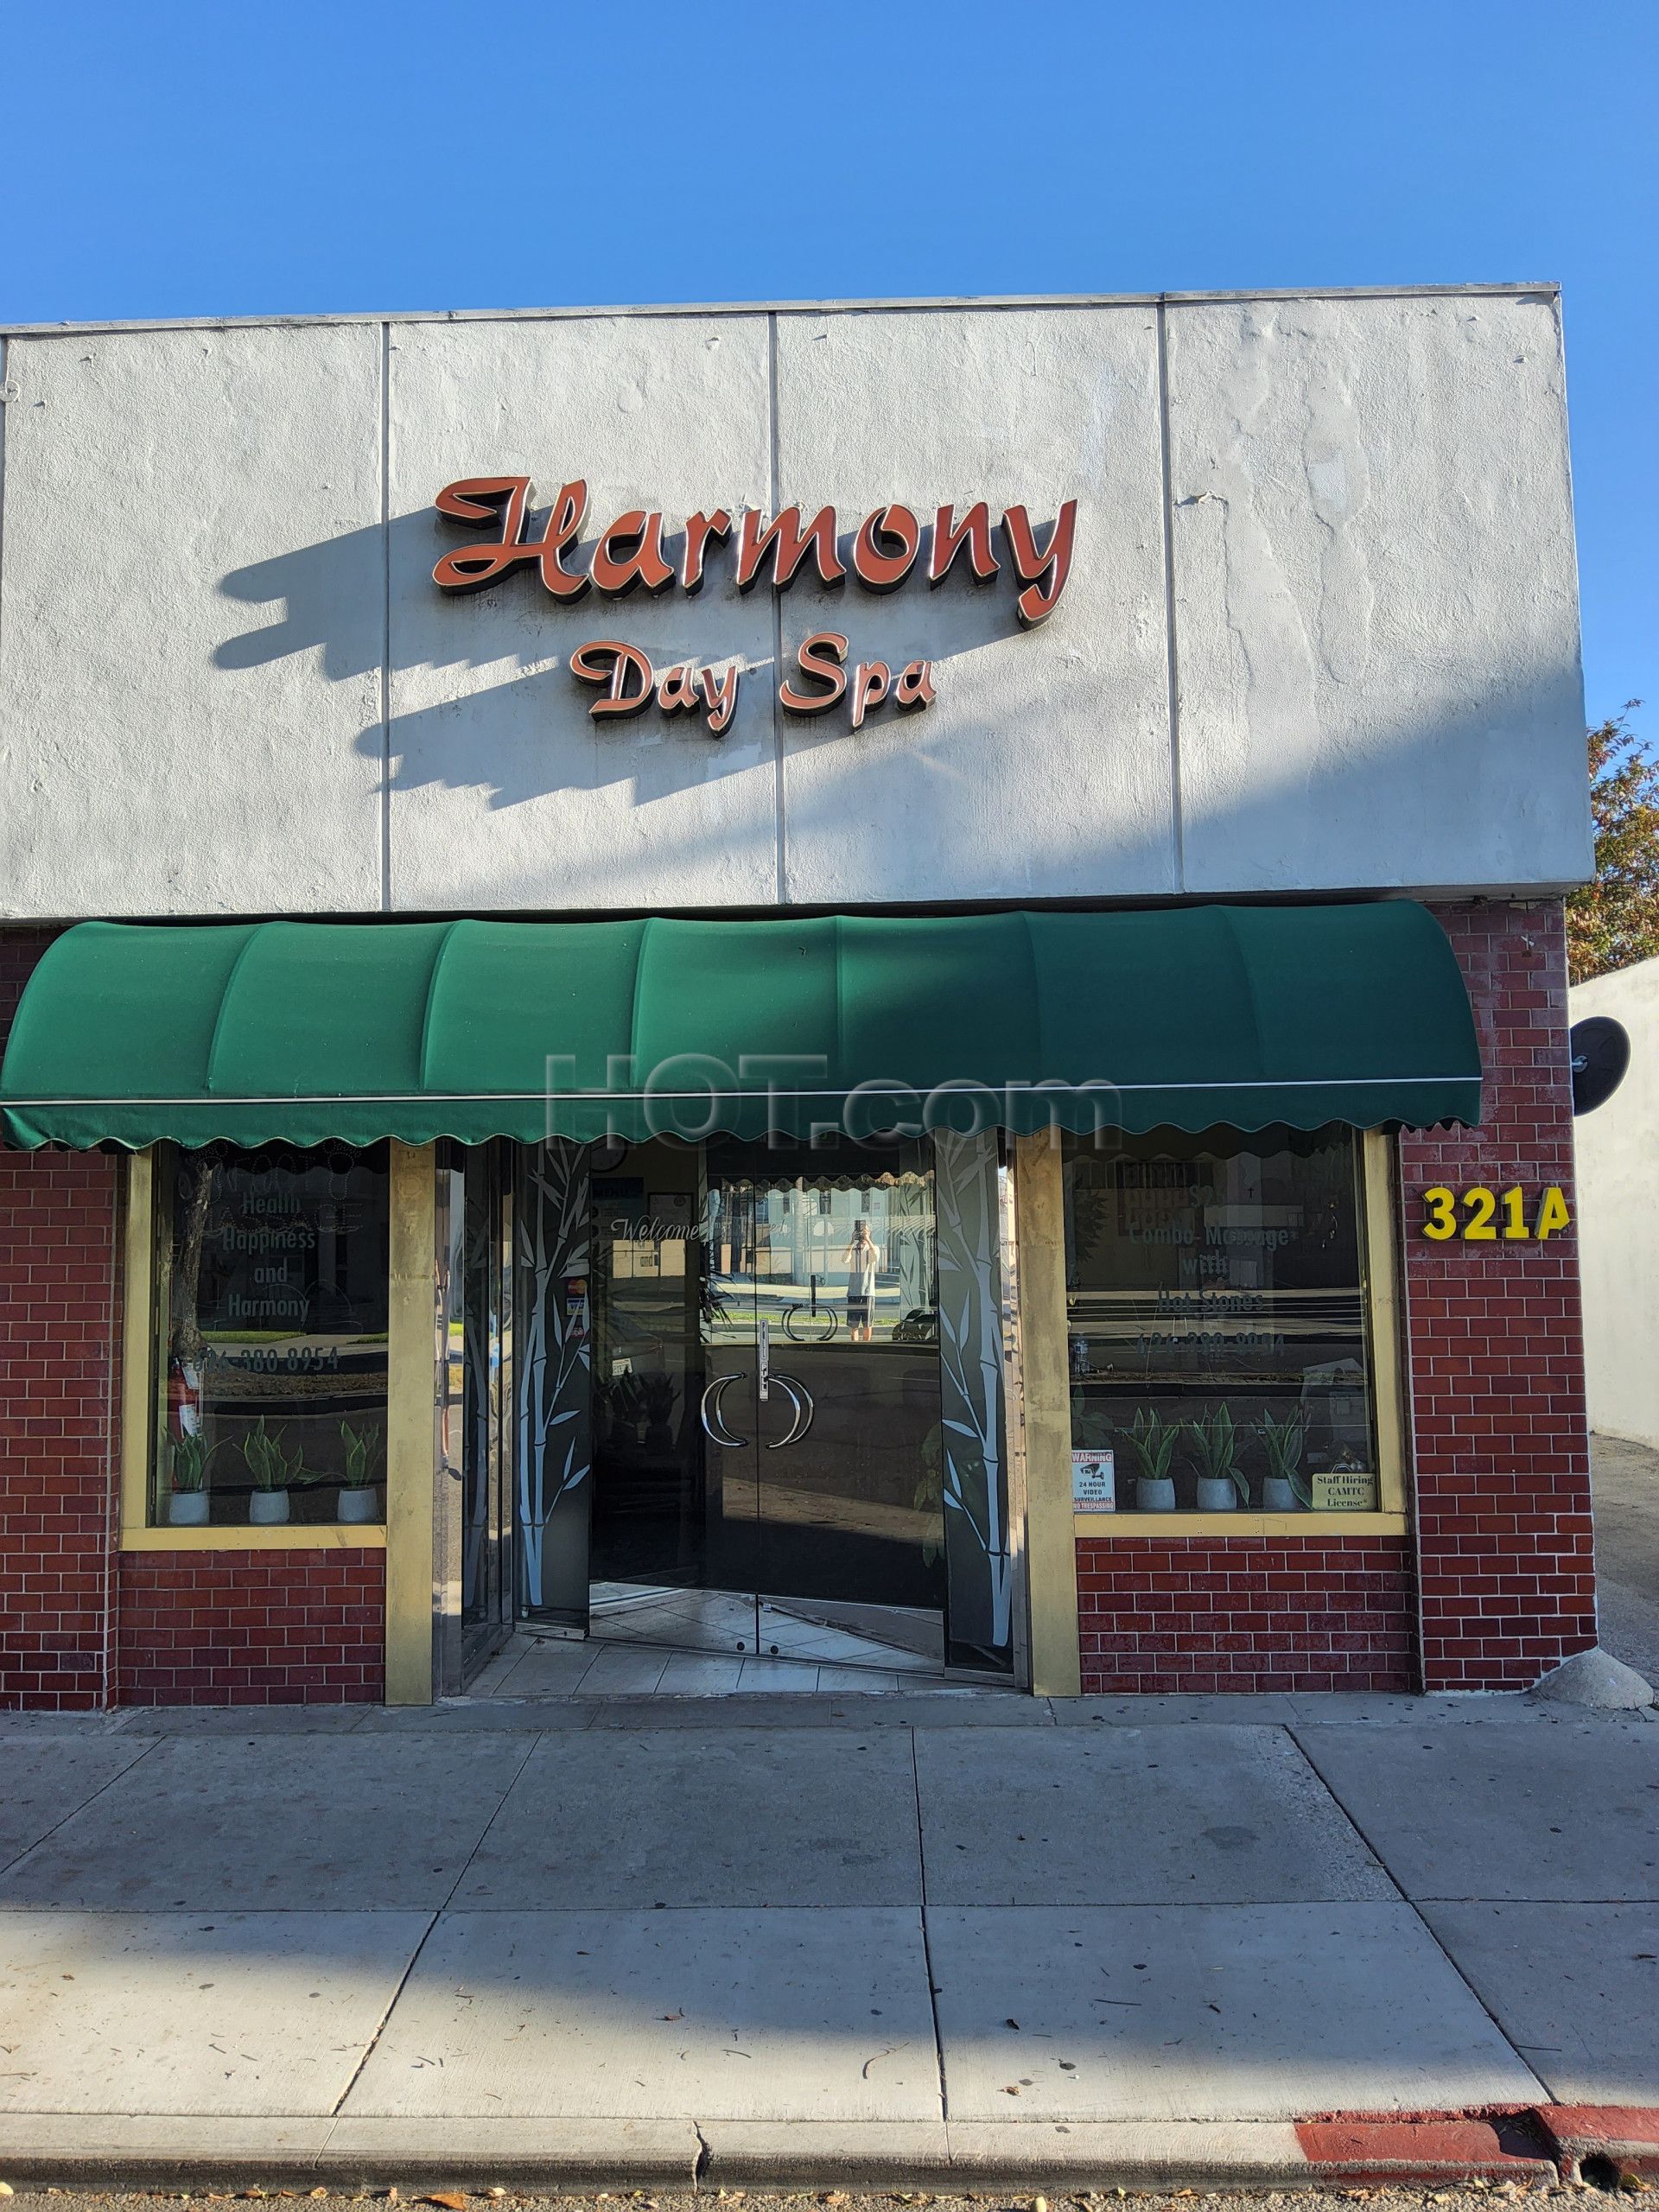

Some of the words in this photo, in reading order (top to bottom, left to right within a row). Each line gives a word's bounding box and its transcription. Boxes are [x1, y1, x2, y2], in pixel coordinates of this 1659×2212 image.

[432, 475, 1078, 630] Harmony
[570, 639, 740, 737] Day
[779, 632, 937, 733] Spa
[242, 1192, 301, 1214] Health
[1423, 1185, 1571, 1241] 321A
[222, 1225, 316, 1255] Happiness
[611, 1216, 702, 1242] Welcome
[254, 1258, 289, 1284] and
[1182, 1249, 1229, 1275] with
[228, 1294, 310, 1325] Harmony
[1158, 1288, 1192, 1313] Hot
[1199, 1287, 1264, 1313] Stones
[1072, 1452, 1112, 1463] WARNING
[1317, 1475, 1341, 1484] Staff
[1343, 1475, 1374, 1485] Hiring
[1328, 1487, 1364, 1496] CAMTC
